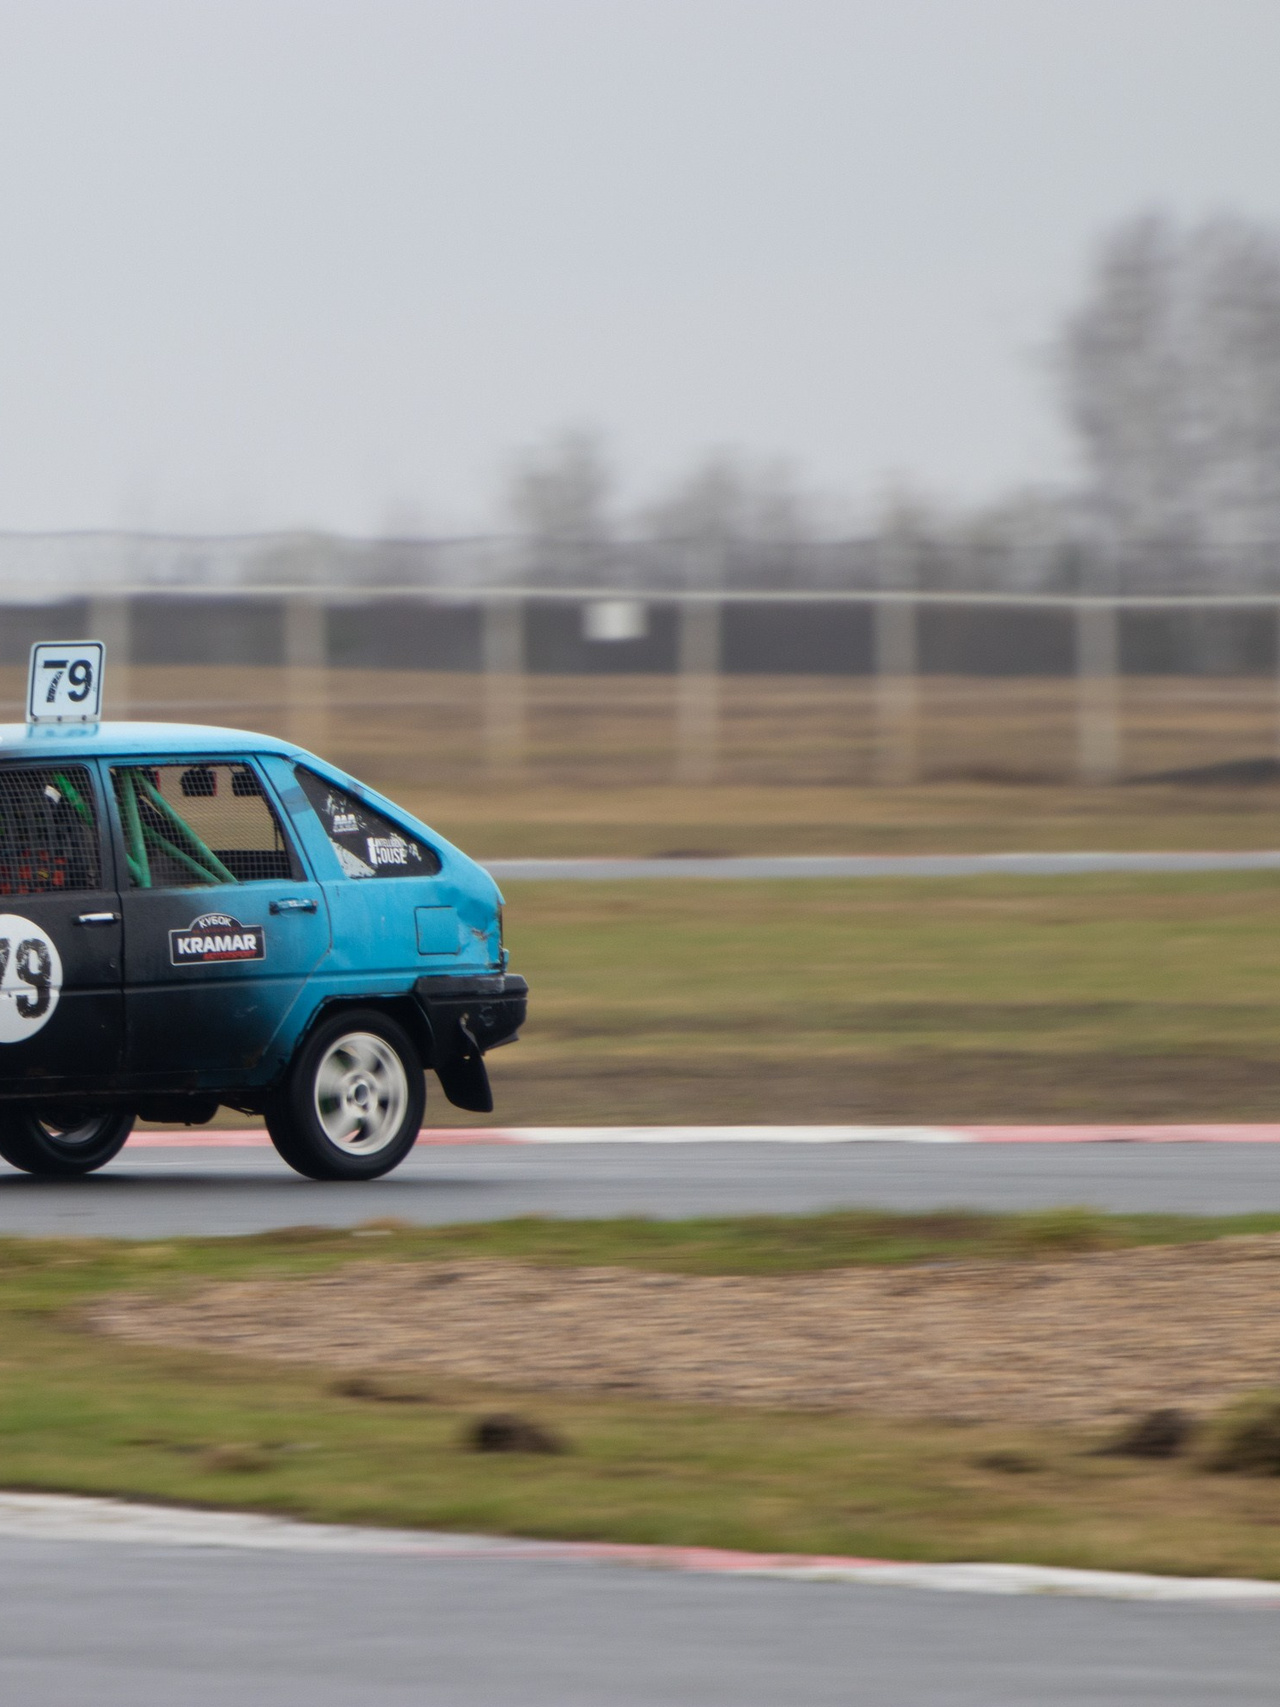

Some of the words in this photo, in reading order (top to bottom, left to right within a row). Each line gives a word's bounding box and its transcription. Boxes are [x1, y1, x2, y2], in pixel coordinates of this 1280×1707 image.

[43, 659, 93, 703] 79
[199, 916, 231, 929] КУБОК
[177, 933, 258, 955] KRAMAR
